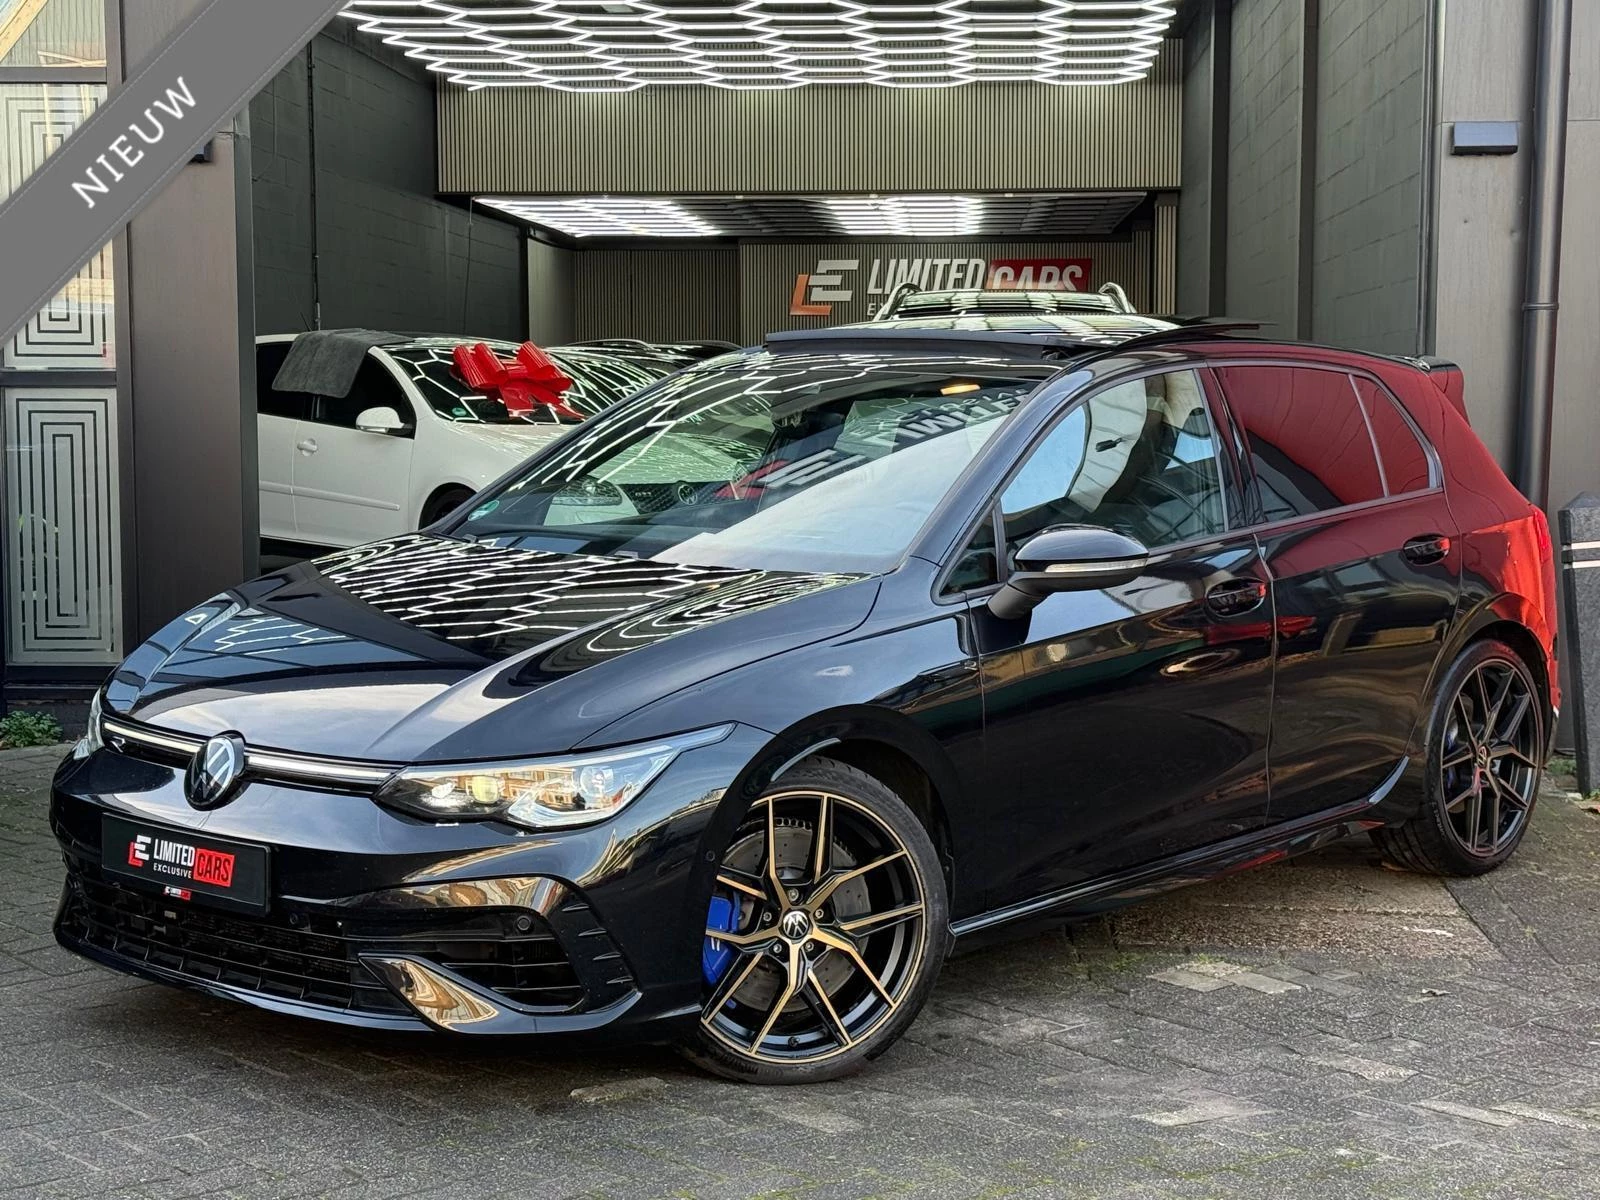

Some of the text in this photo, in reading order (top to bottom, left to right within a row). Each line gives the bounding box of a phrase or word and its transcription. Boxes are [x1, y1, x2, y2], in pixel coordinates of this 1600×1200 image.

[867, 259, 1083, 294] LIMITED CARS
[153, 838, 231, 882] LIMITED CARS
[153, 862, 192, 879] EXCLUSIVE
